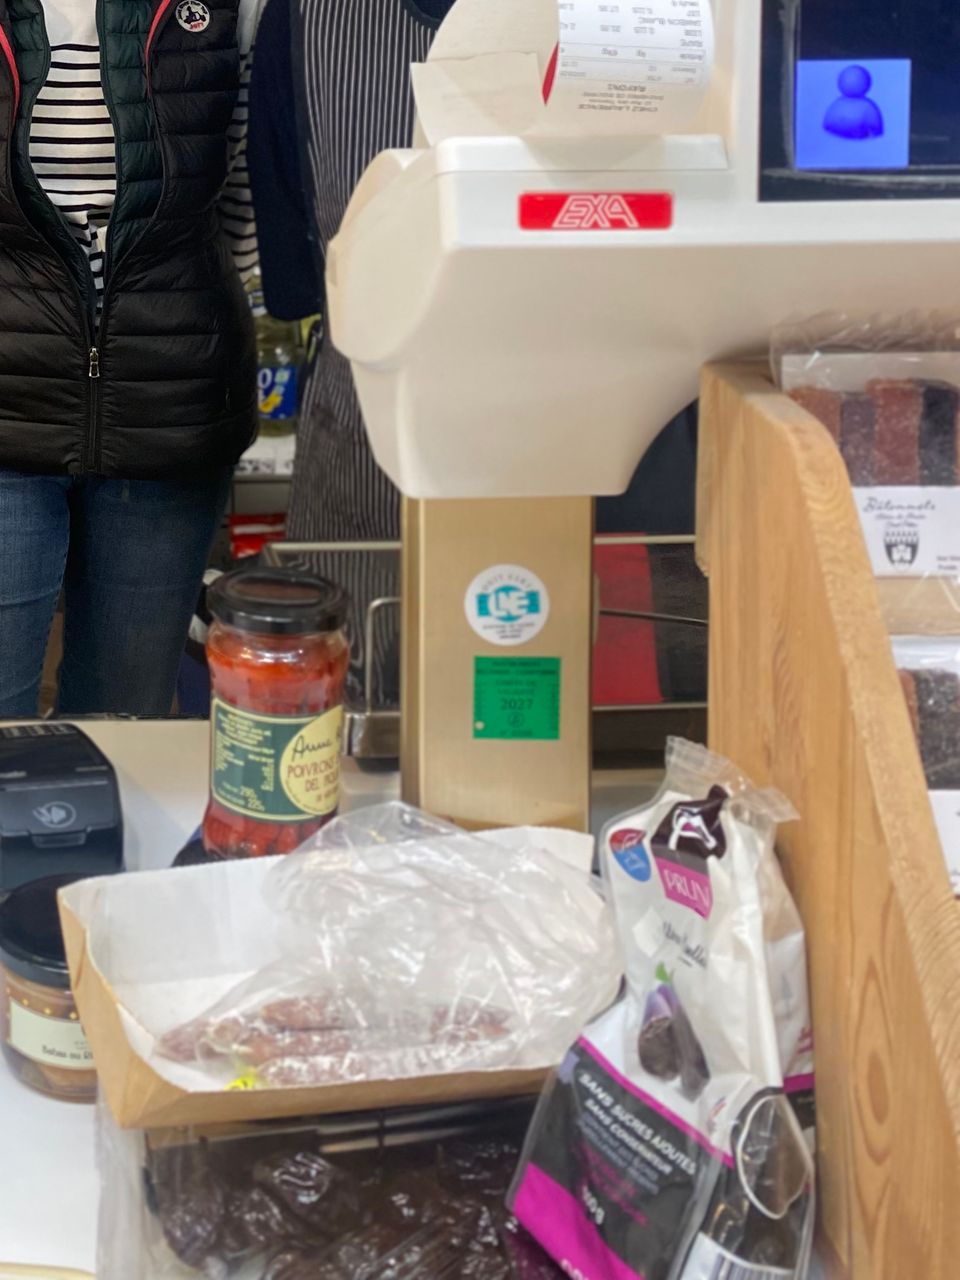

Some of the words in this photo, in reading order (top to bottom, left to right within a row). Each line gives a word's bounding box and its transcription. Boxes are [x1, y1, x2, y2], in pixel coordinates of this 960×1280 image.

[664, 868, 709, 907] PRUN
[578, 1073, 615, 1107] SANS
[612, 1104, 654, 1142] SUCRES
[584, 1098, 611, 1126] SANS
[609, 1122, 674, 1175] CONSERVATEUR
